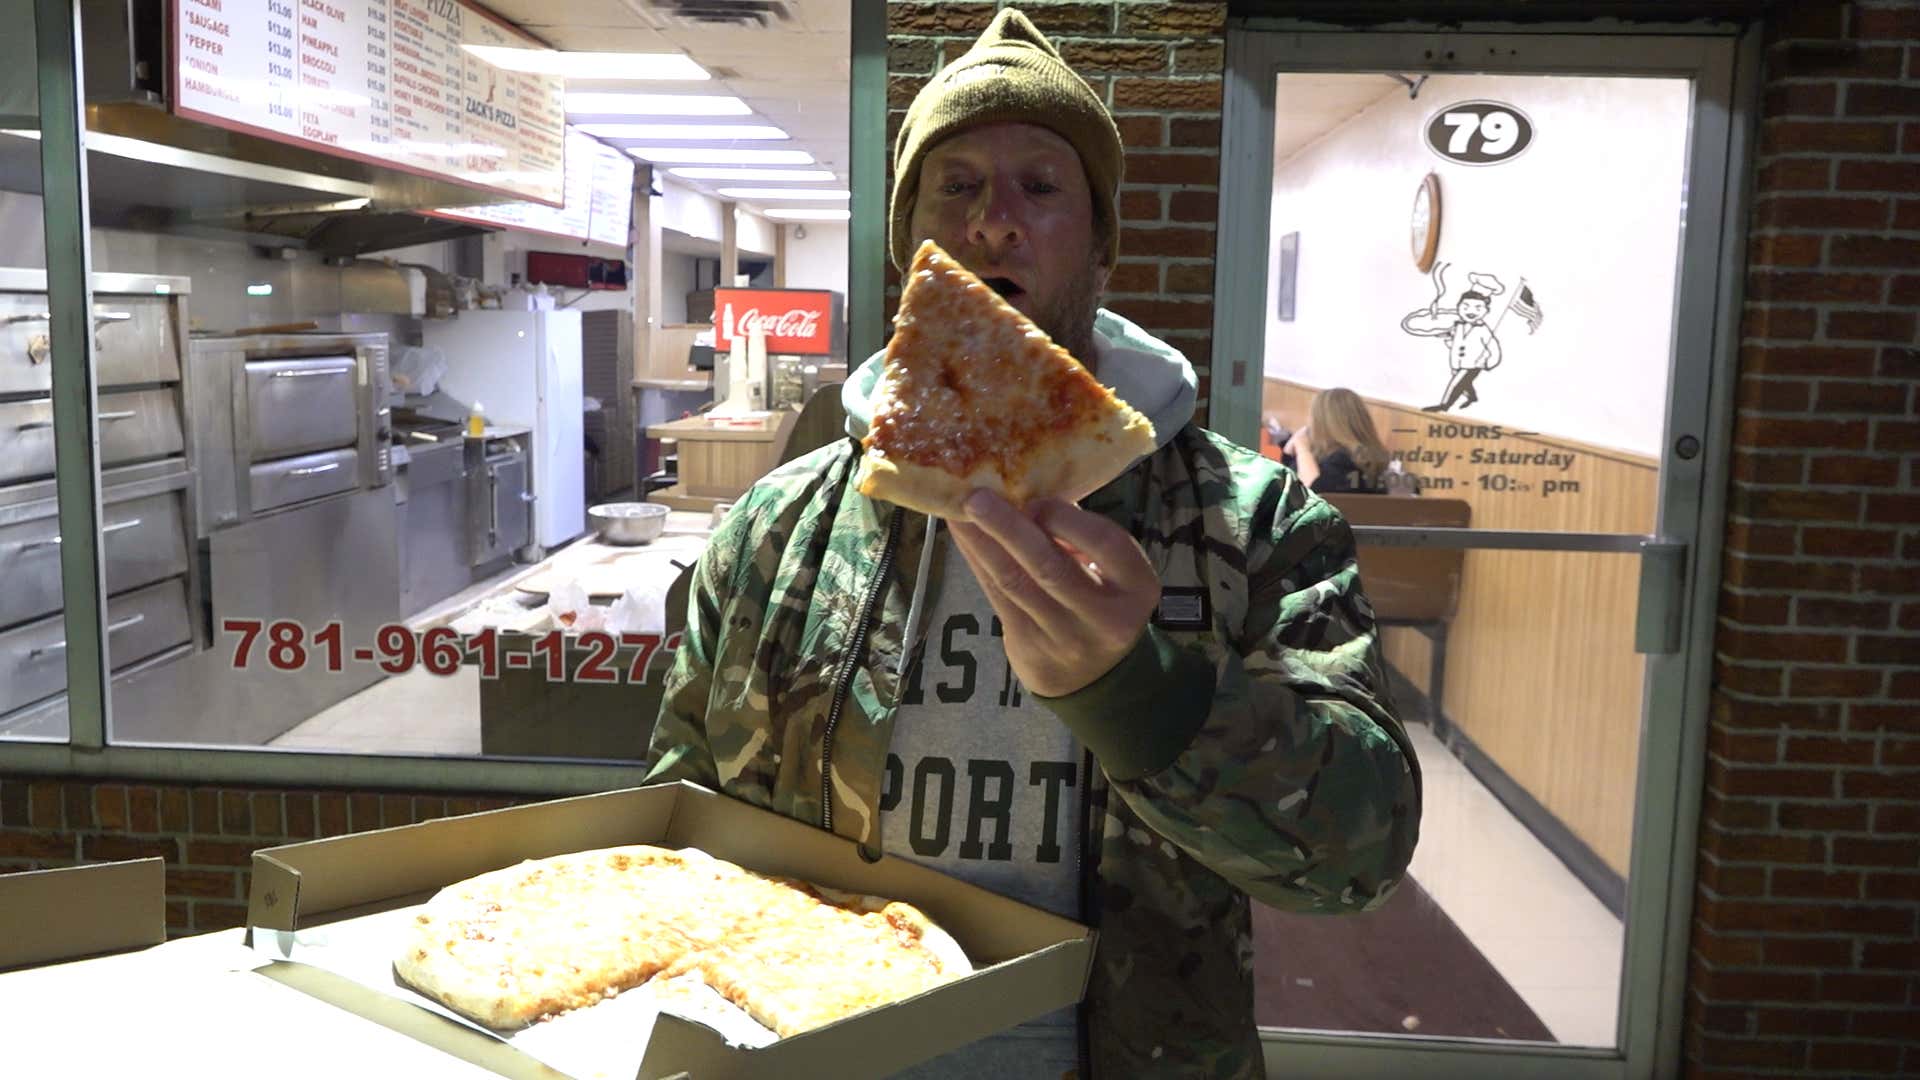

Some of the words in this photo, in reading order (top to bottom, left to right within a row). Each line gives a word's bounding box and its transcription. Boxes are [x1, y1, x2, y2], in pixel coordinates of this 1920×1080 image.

[427, 0, 461, 26] PIZZA
[495, 108, 516, 131] PIZZA
[1444, 111, 1519, 155] 79
[737, 308, 823, 338] Coca-Cola
[1428, 424, 1503, 440] HOURS
[1470, 448, 1576, 471] Saturday
[1542, 483, 1580, 498] pm
